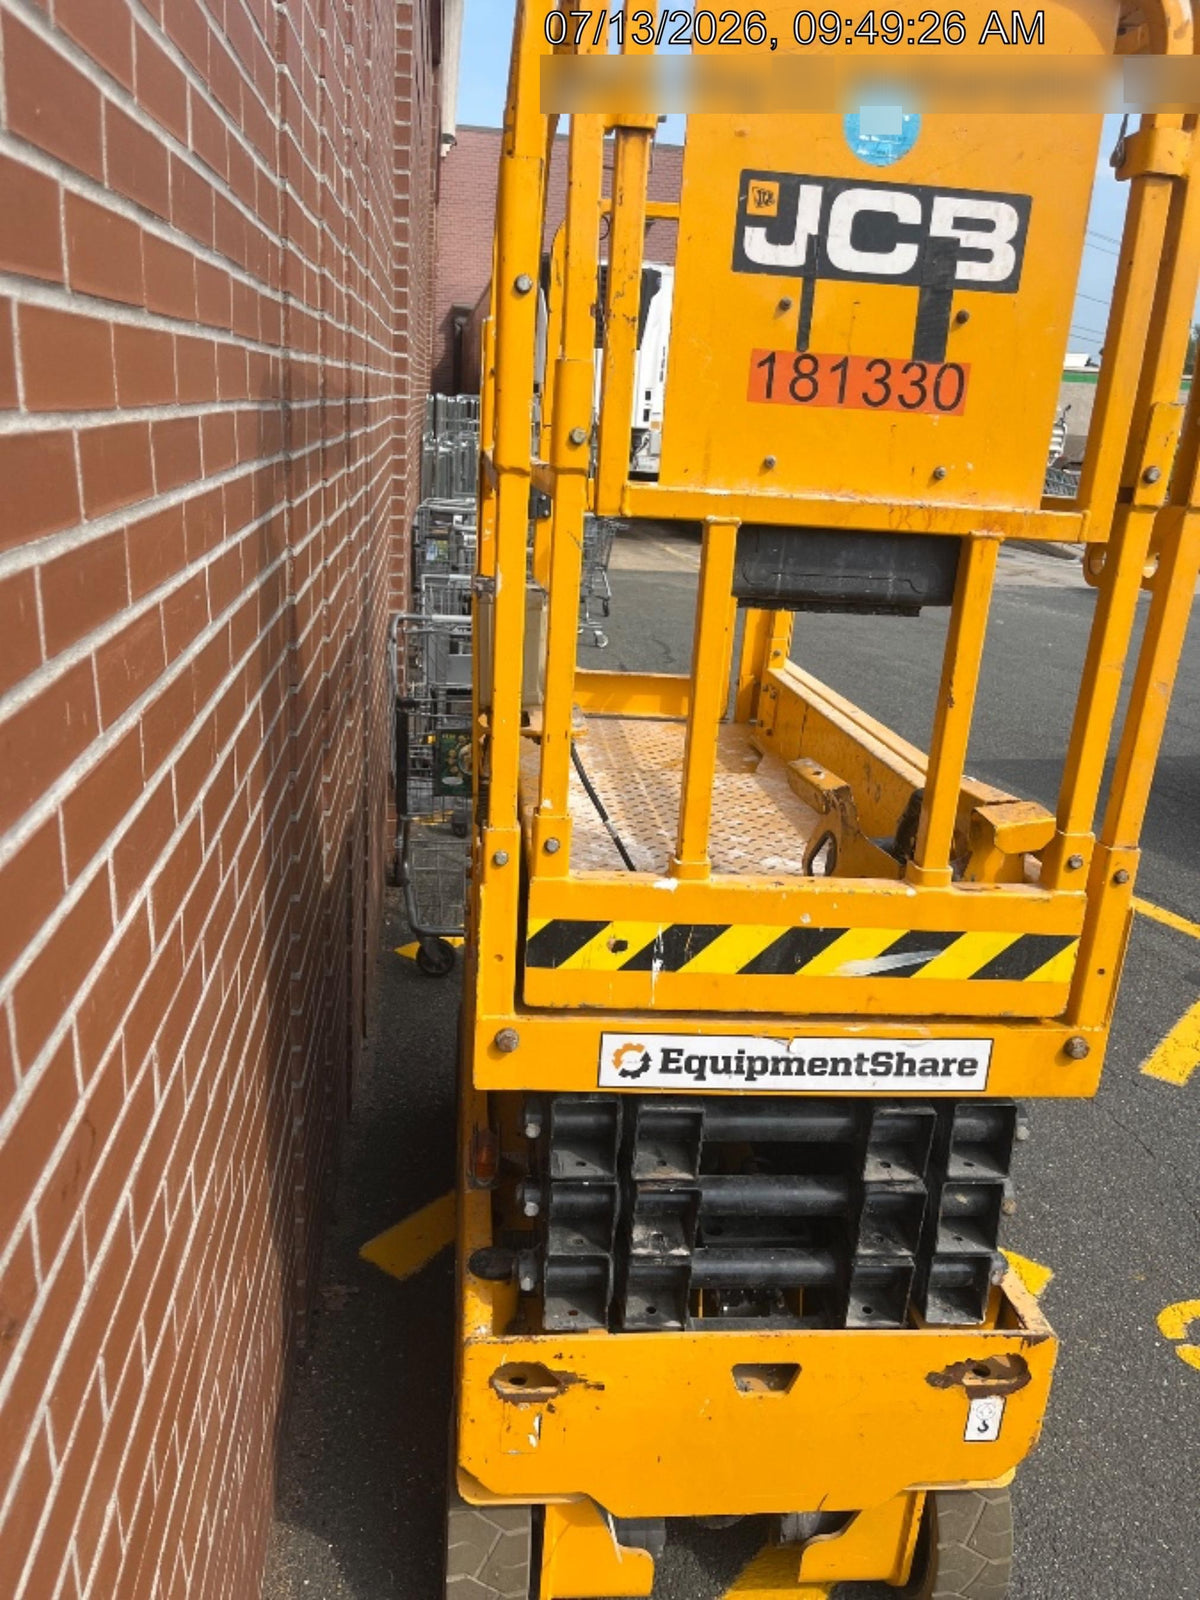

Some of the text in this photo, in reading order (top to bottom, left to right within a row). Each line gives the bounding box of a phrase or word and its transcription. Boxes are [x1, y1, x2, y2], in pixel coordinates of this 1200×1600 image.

[742, 184, 1021, 283] JCB
[757, 351, 965, 411] 181330
[658, 1047, 979, 1082] EquipmentShare
